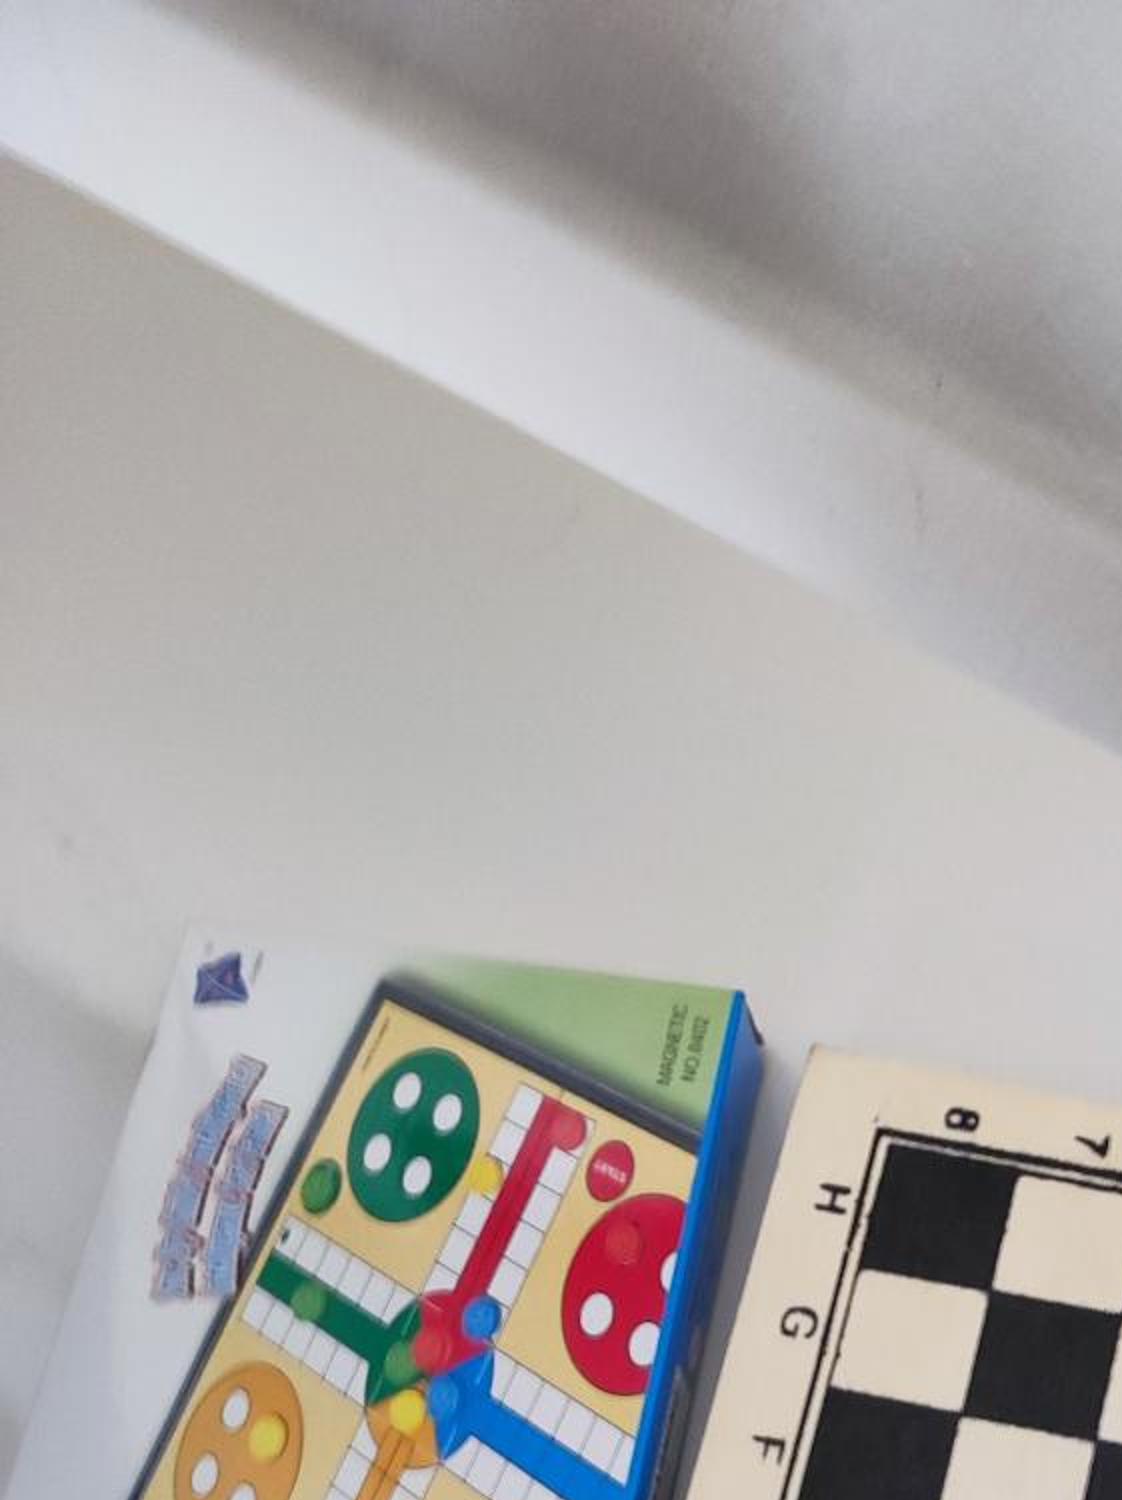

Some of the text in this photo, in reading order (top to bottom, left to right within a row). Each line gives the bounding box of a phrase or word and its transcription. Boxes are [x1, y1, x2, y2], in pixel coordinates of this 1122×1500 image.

[656, 1003, 689, 1087] MAGNETIC
[945, 1107, 980, 1132] 8
[1075, 1134, 1111, 1158] 7
[813, 1183, 852, 1216] H
[780, 1306, 818, 1339] G
[752, 1434, 785, 1465] F
